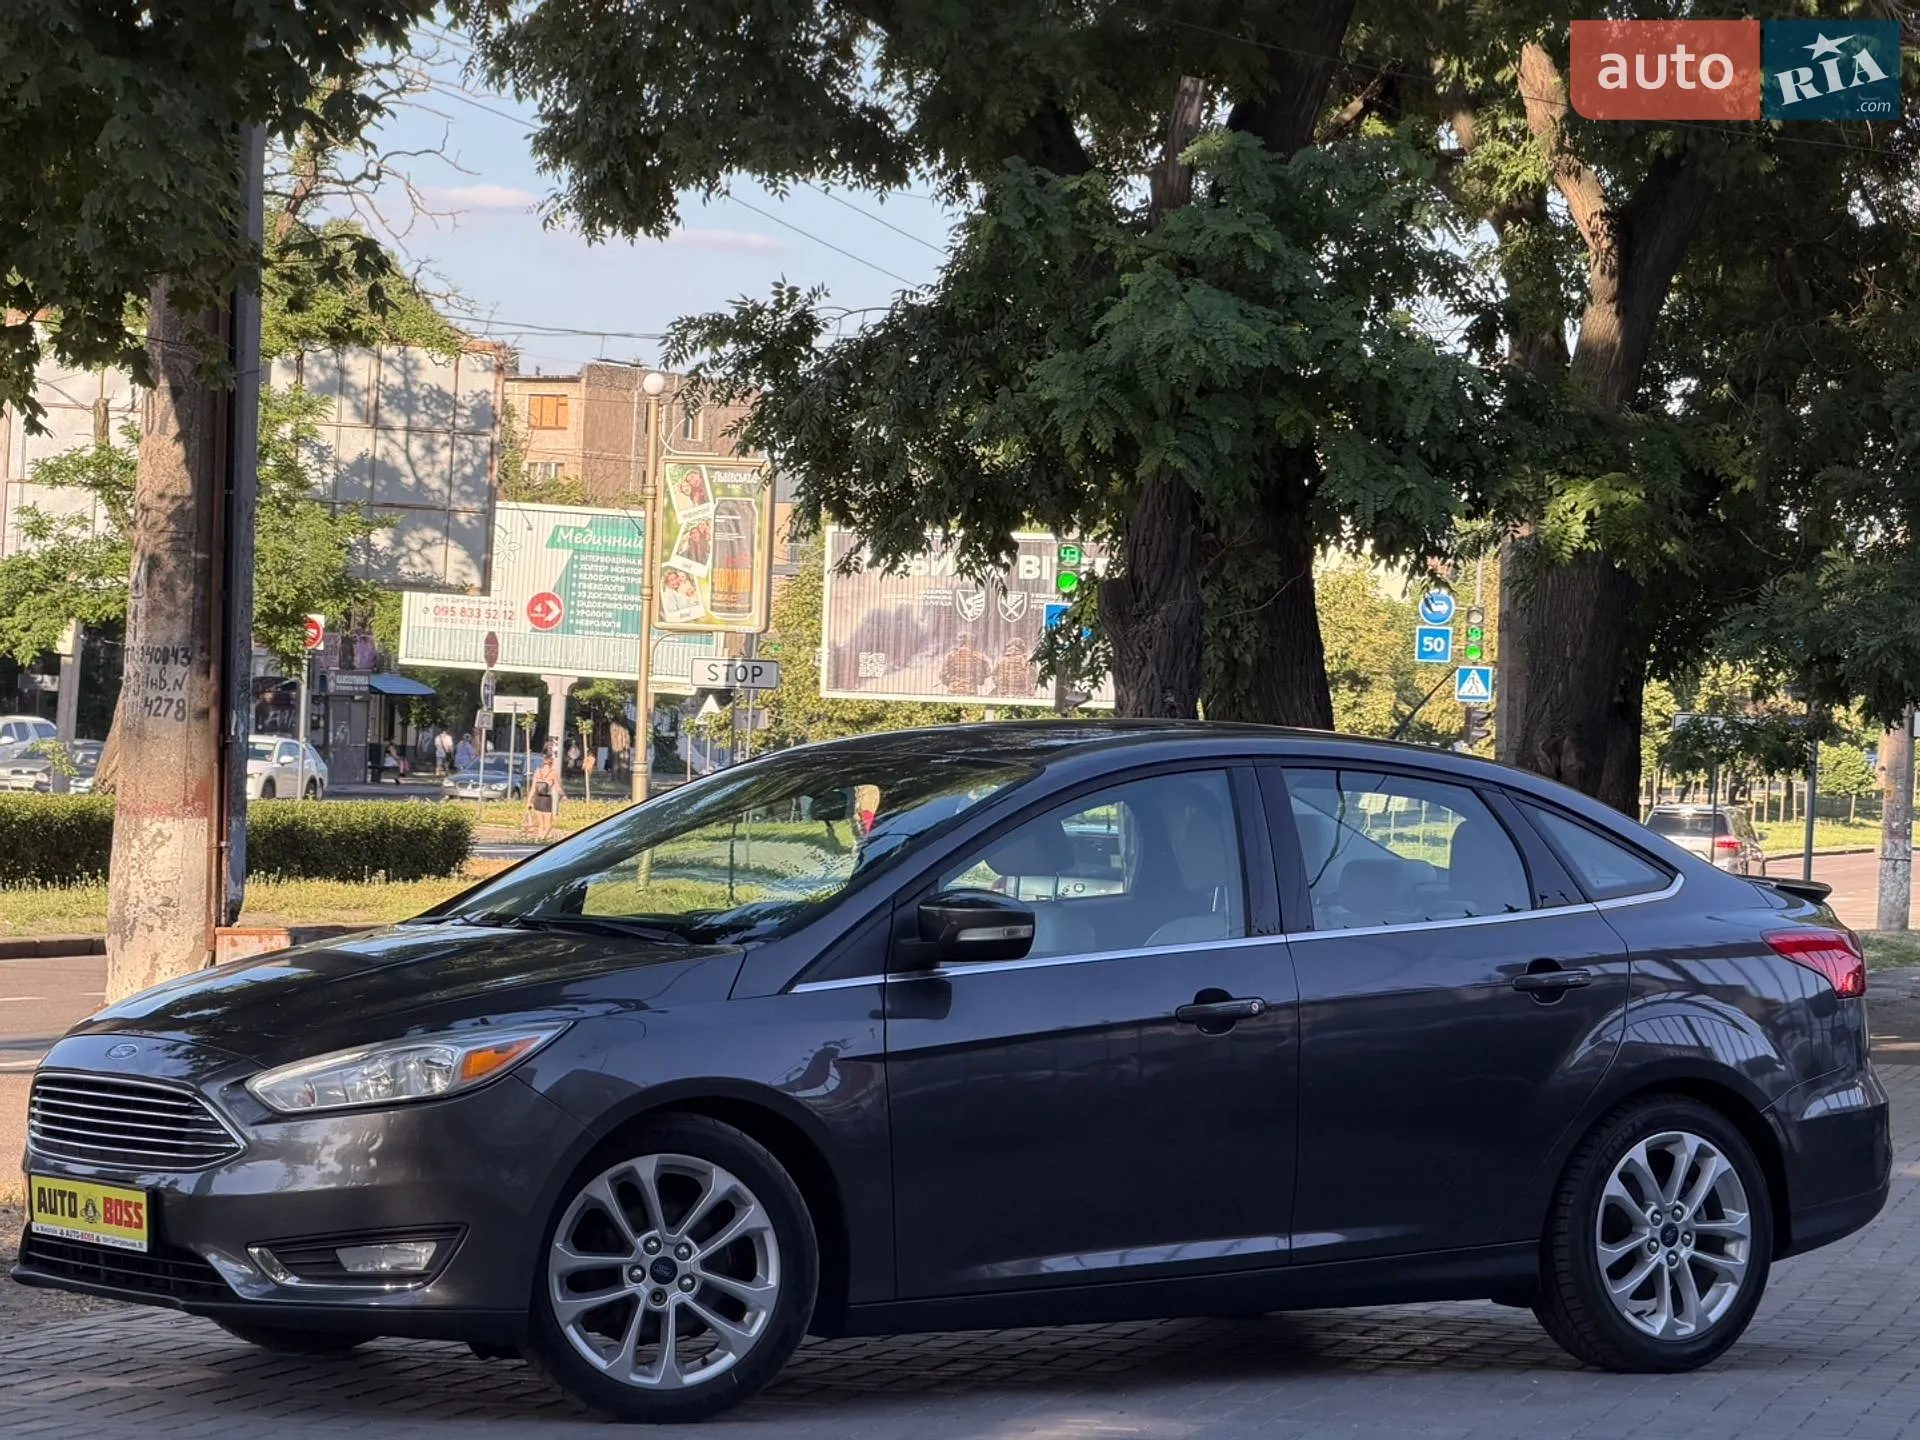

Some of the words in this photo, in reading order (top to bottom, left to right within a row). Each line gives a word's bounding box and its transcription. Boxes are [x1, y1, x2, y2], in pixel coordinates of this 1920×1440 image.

[556, 528, 643, 548] Медичний
[433, 605, 456, 616] 095
[460, 606, 481, 618] 833
[485, 608, 499, 620] 52
[503, 609, 514, 620] 12
[1422, 636, 1445, 653] 50
[707, 663, 763, 683] STOP
[144, 696, 187, 722] 4278
[37, 1186, 78, 1219] AUTO
[103, 1196, 144, 1230] BOSS
